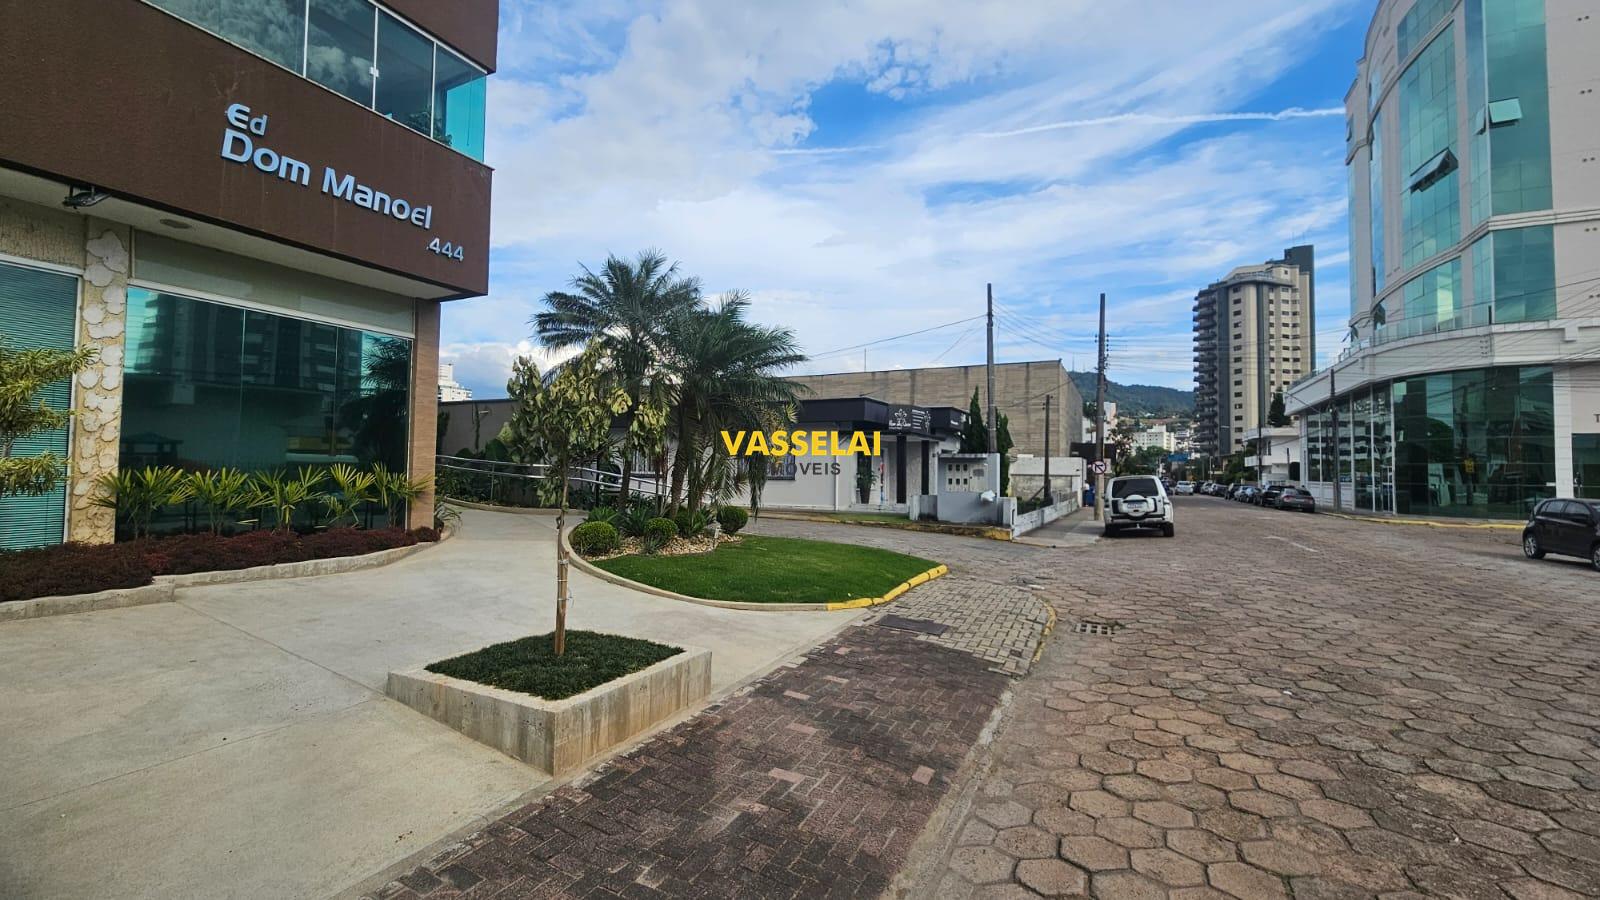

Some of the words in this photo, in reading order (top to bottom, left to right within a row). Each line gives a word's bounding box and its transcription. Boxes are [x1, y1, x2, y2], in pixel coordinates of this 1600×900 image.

[225, 103, 268, 136] Ed
[221, 128, 311, 187] Dom
[321, 166, 433, 230] Manoel
